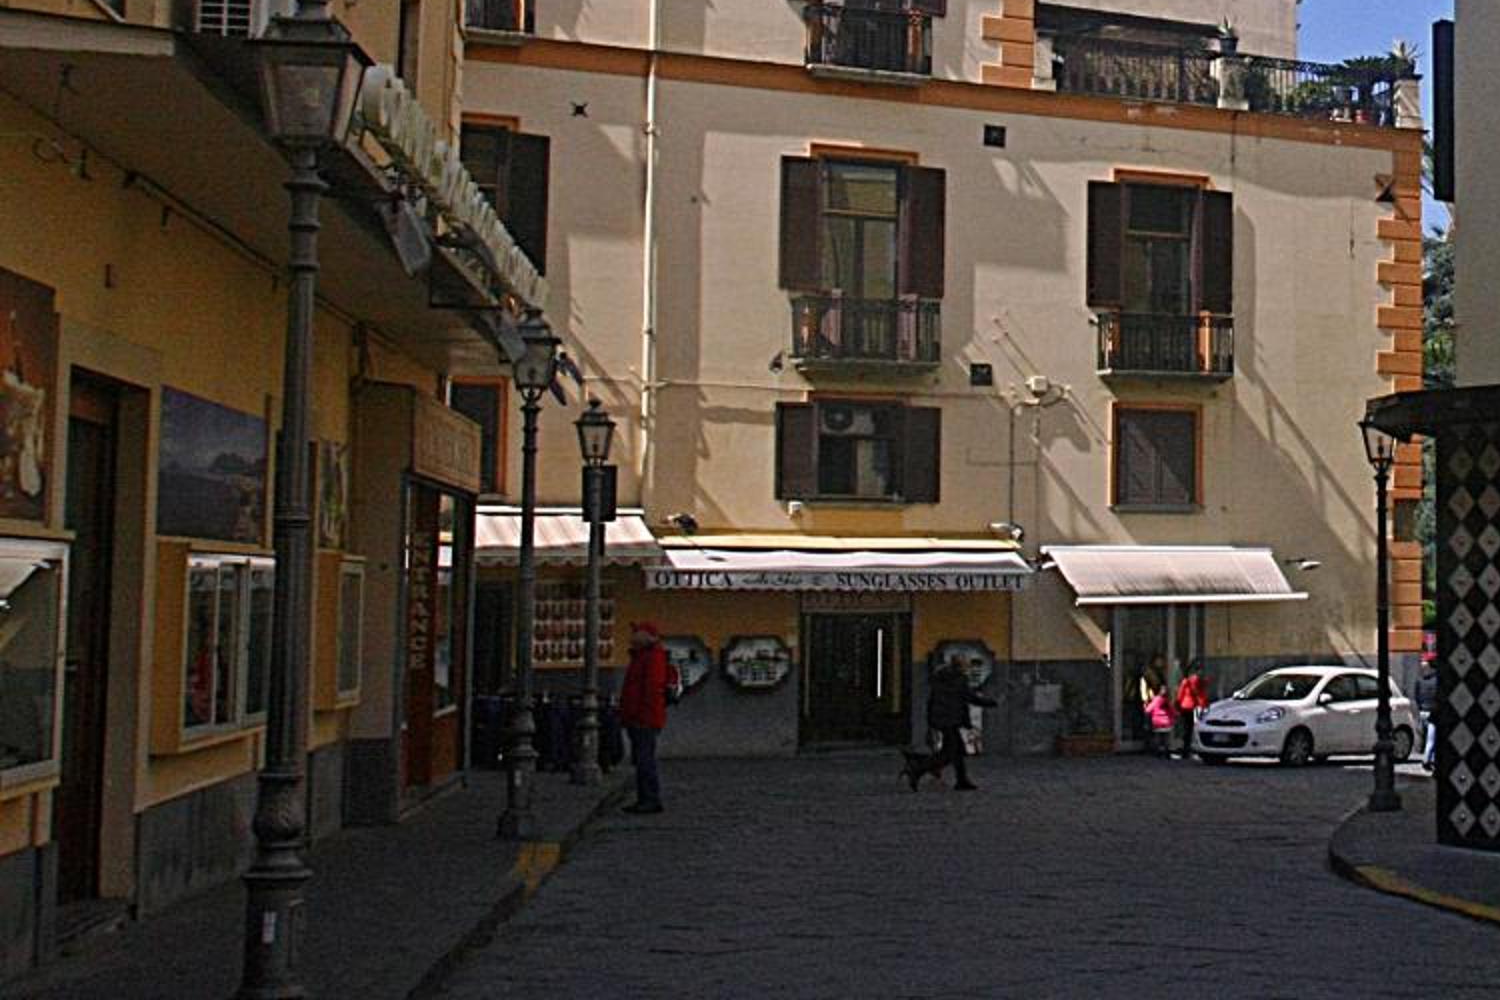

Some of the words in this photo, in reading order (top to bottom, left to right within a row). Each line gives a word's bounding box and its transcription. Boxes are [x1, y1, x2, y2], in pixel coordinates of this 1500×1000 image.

[655, 572, 733, 586] OTTICA
[834, 573, 947, 588] SUNGLASSES
[955, 574, 1024, 589] OUTLET
